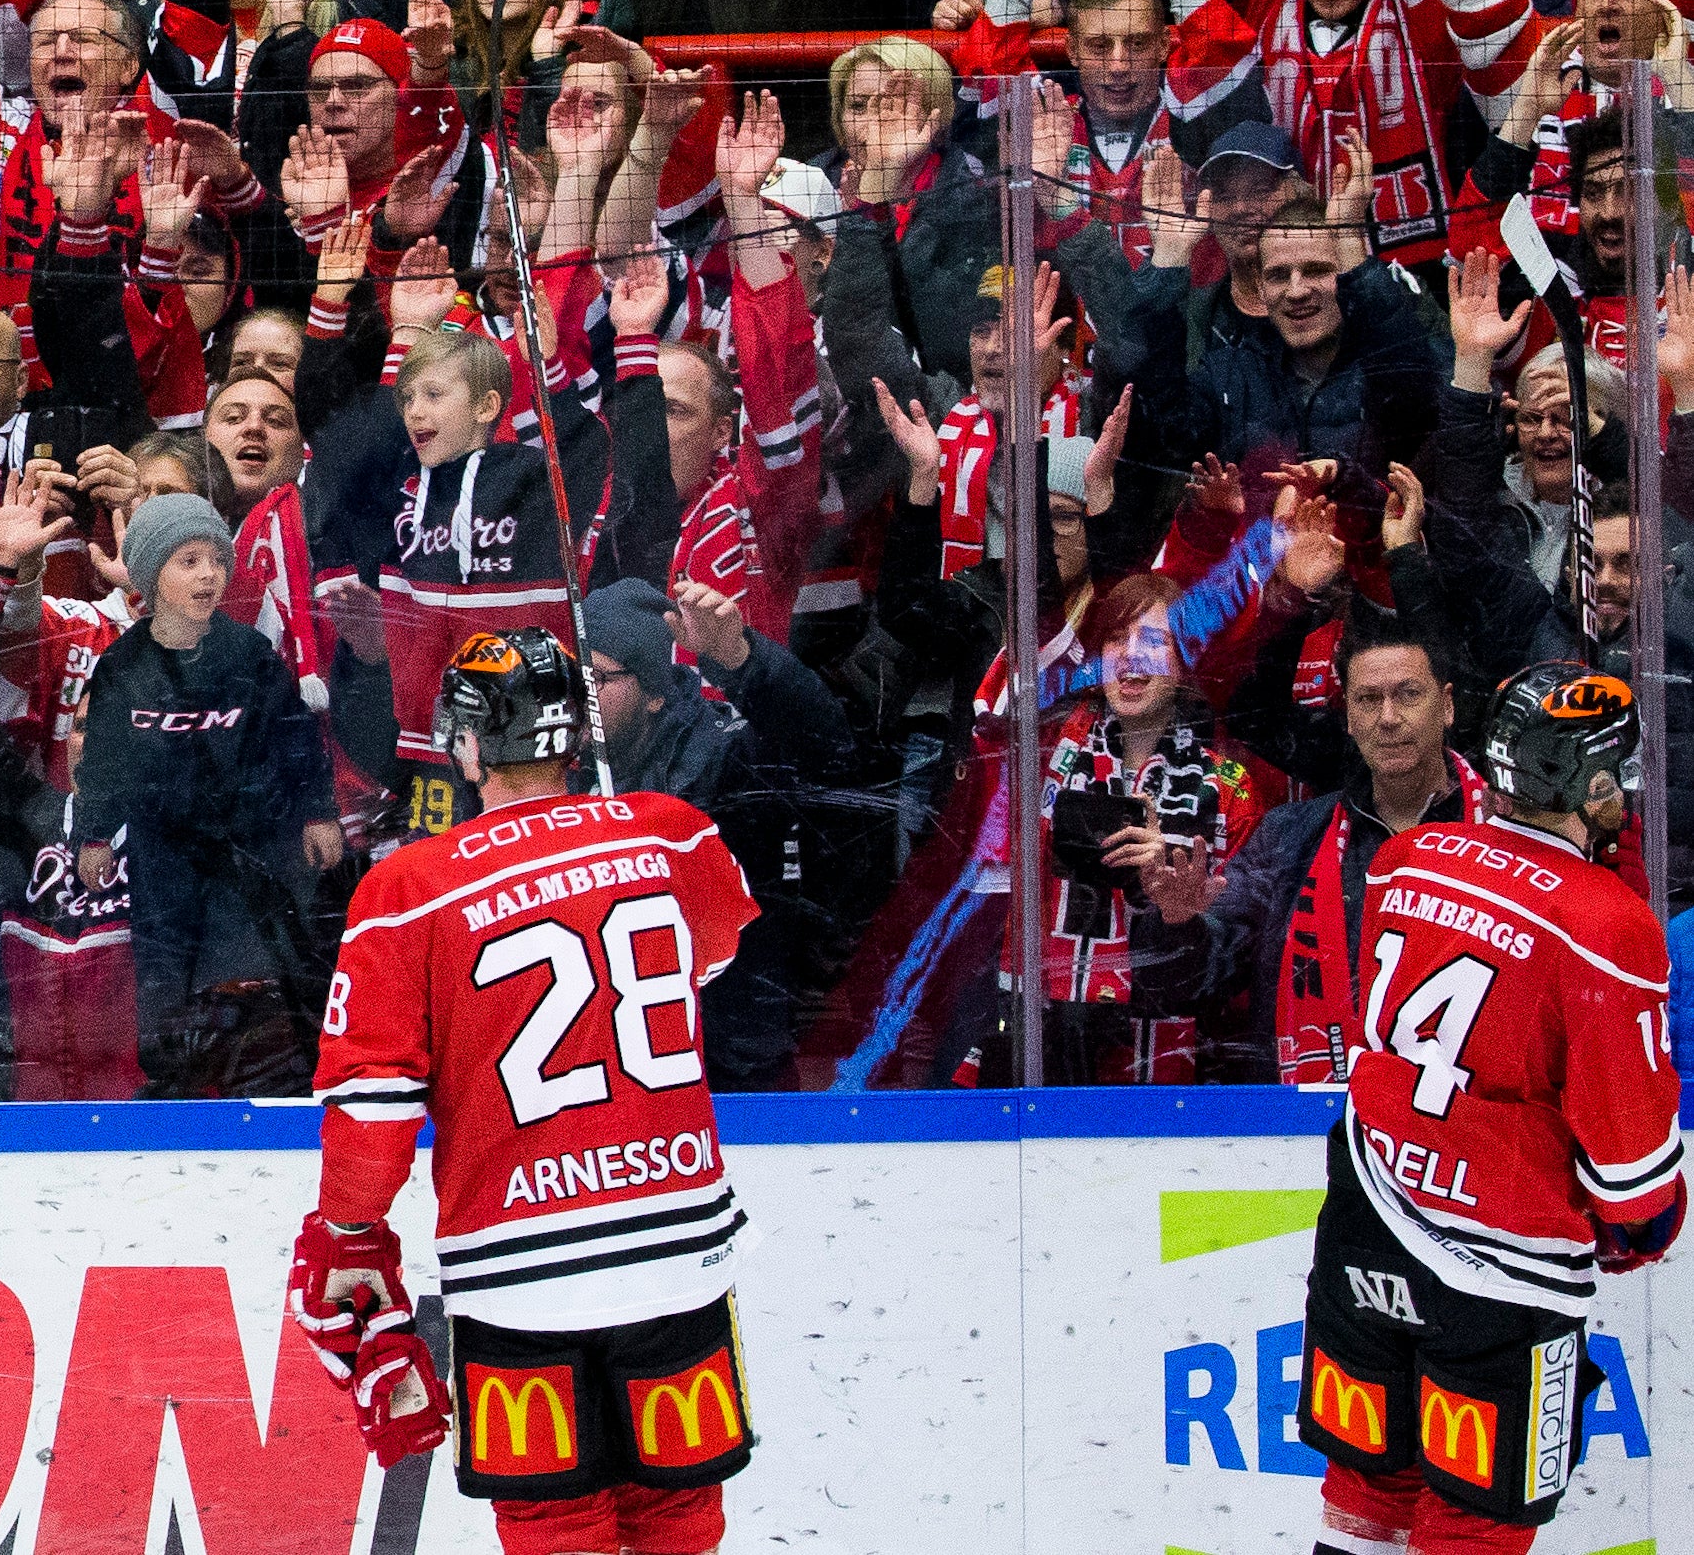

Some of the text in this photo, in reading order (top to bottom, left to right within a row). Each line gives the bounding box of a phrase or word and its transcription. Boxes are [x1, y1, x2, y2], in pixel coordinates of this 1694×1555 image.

[1577, 462, 1600, 642] BAUER
[129, 706, 244, 733] CCM
[582, 665, 606, 743] BAUER
[1548, 682, 1625, 715] KTM
[534, 728, 570, 759] 28
[1491, 763, 1517, 793] 14
[452, 798, 634, 860] CONSTO
[1412, 830, 1561, 891] CONSTO
[461, 852, 671, 932] MALMBERGS
[472, 892, 705, 1128] 28
[1363, 927, 1500, 1121] 14
[502, 1128, 714, 1208] ARNESSON
[1344, 1265, 1425, 1325] NA
[1163, 1319, 1654, 1478] REA
